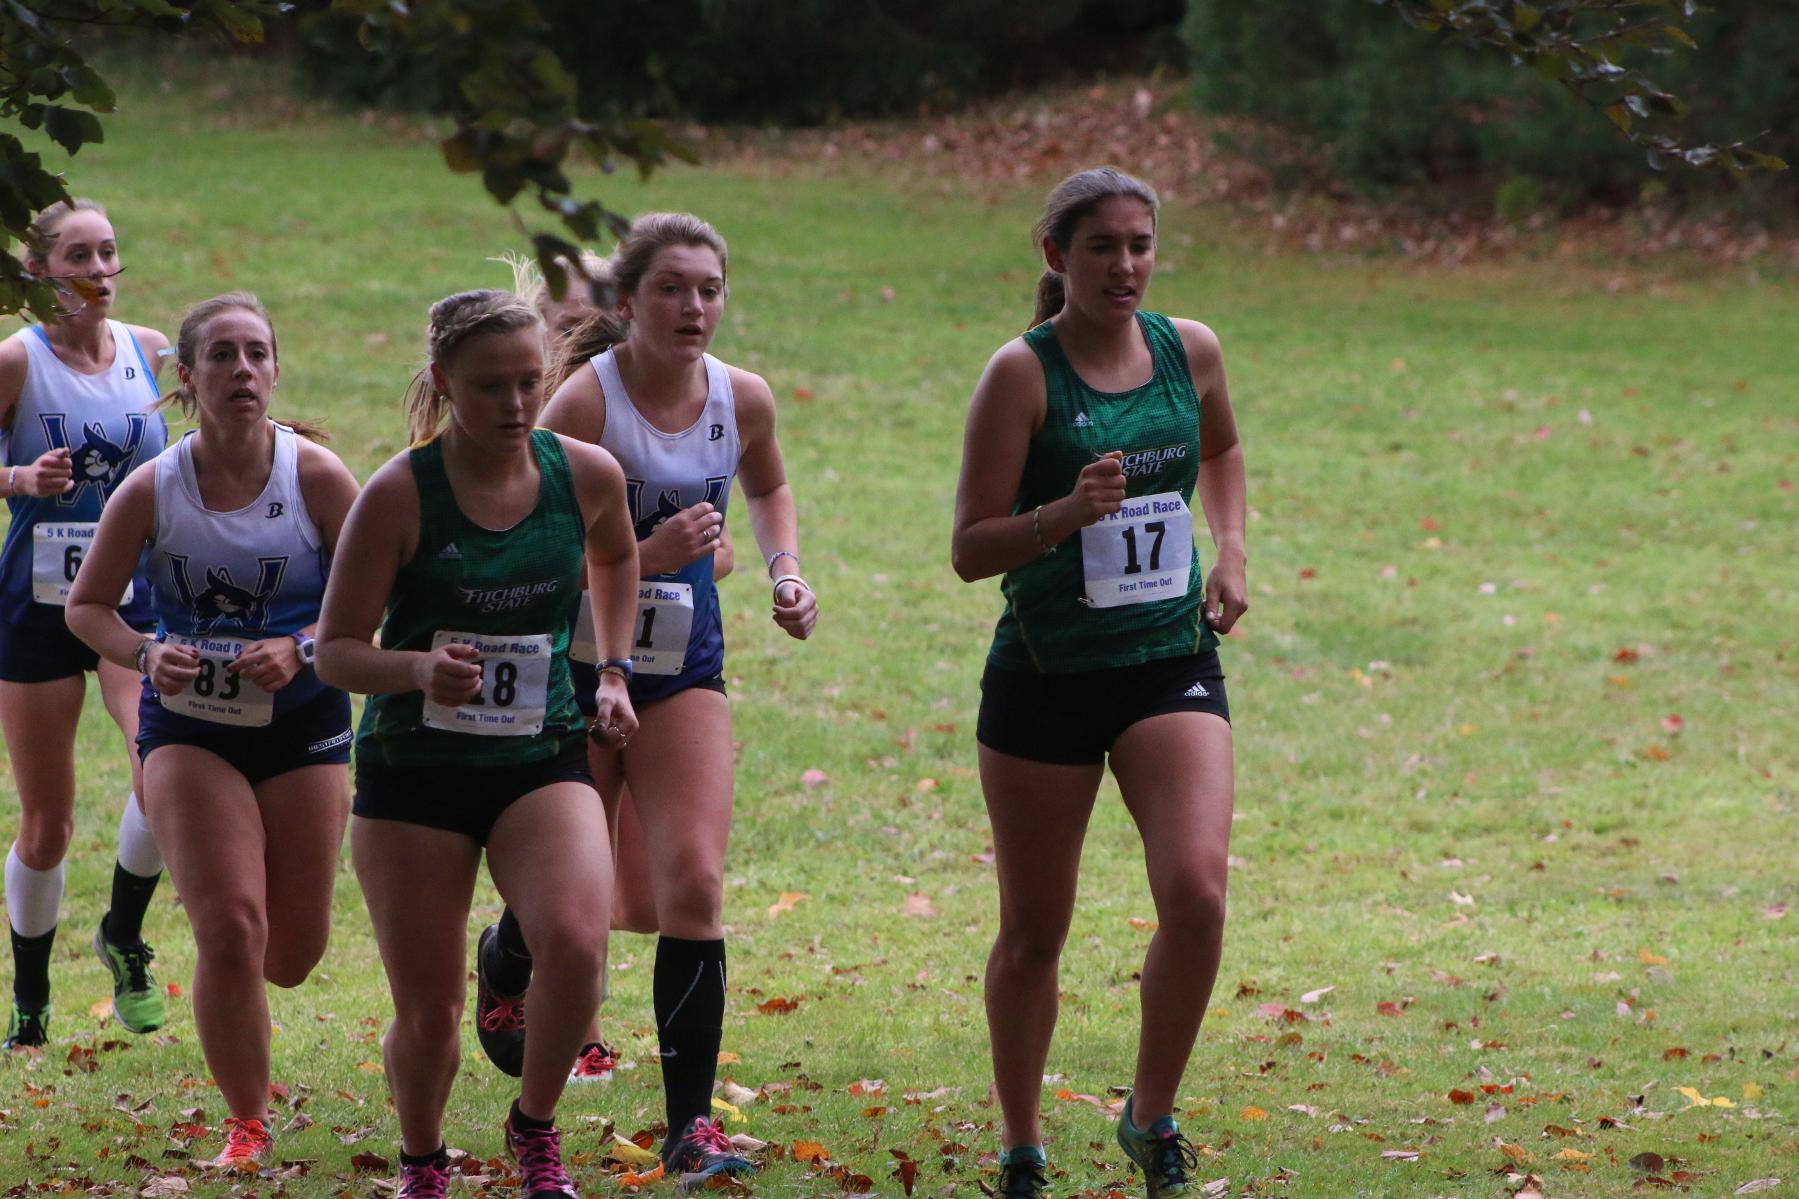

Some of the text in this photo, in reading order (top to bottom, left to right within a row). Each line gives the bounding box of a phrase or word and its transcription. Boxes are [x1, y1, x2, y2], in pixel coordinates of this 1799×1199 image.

[1120, 444, 1187, 467] TCHBURG
[1122, 461, 1165, 477] STATE
[1120, 503, 1150, 519] Road
[1152, 500, 1181, 514] Race
[47, 527, 95, 538] 5 K Road
[1121, 520, 1166, 575] 17
[457, 578, 560, 604] FITCHBURG
[1119, 577, 1173, 593] First Time Out
[655, 588, 681, 601] Race
[481, 597, 533, 613] STATE
[201, 640, 231, 653] Road
[475, 640, 506, 654] Road
[510, 642, 540, 654] Race
[642, 655, 656, 663] Out
[194, 658, 241, 700] 83
[188, 700, 242, 715] First Time Out
[456, 711, 516, 724] First Time Out
